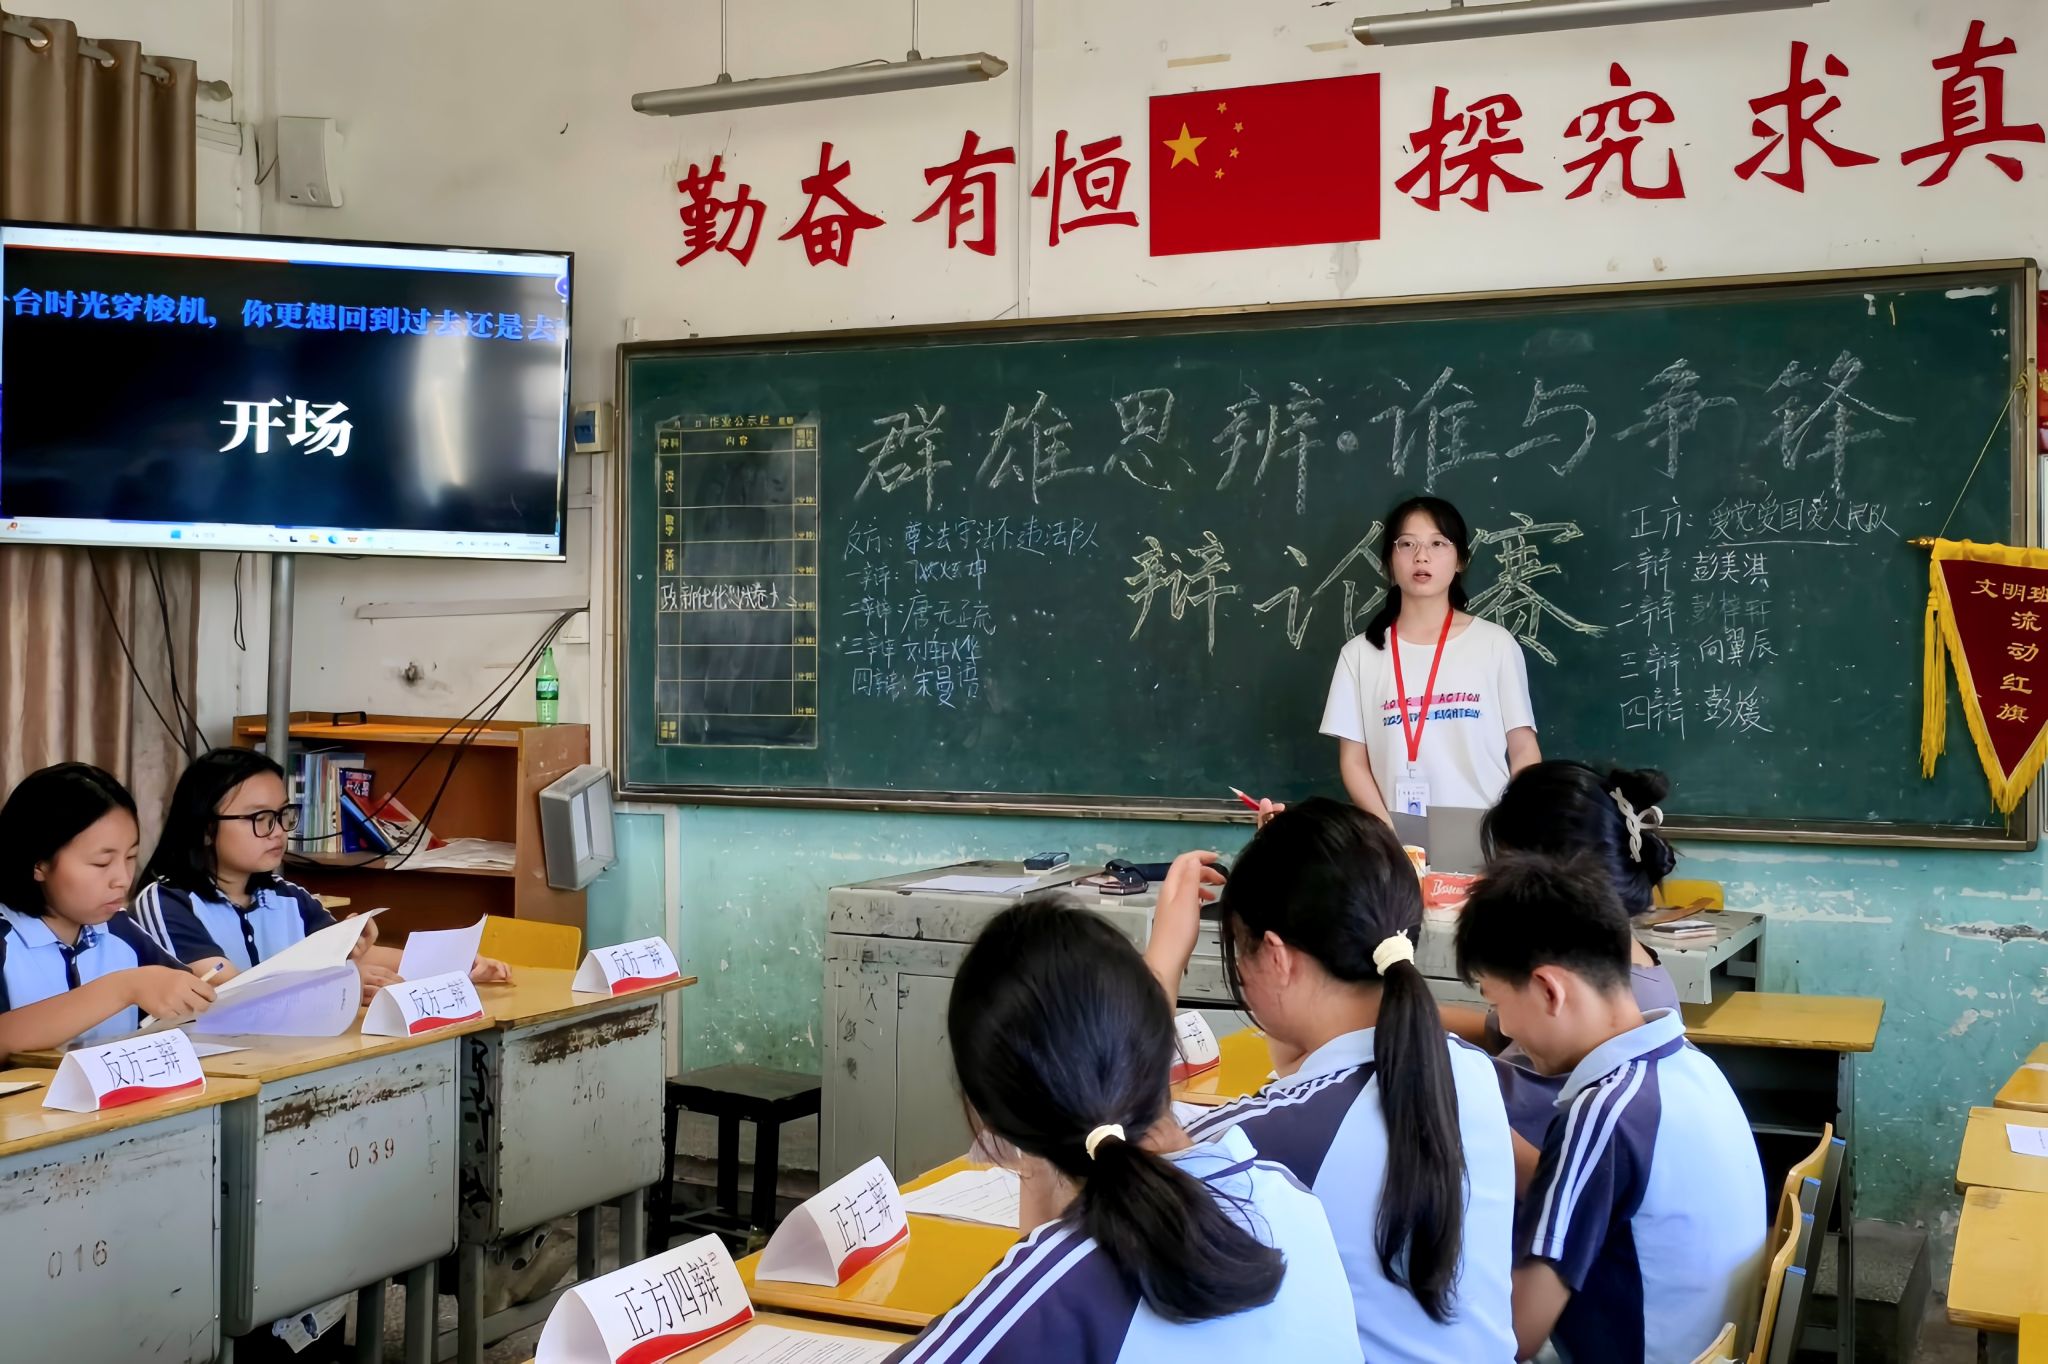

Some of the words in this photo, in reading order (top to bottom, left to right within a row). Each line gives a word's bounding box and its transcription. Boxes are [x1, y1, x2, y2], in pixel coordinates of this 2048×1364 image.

[1395, 20, 2046, 212] 探究求真
[677, 130, 1140, 267] 勤奋有恒
[219, 395, 353, 457] 开场
[1970, 579, 2048, 602] 文明班
[1996, 611, 2042, 723] 流动红旗
[1383, 697, 1412, 710] LOE
[1439, 693, 1480, 703] ACTION
[349, 1137, 394, 1169] 039
[48, 1240, 107, 1278] 016
[614, 1253, 723, 1341] 正方四辩
